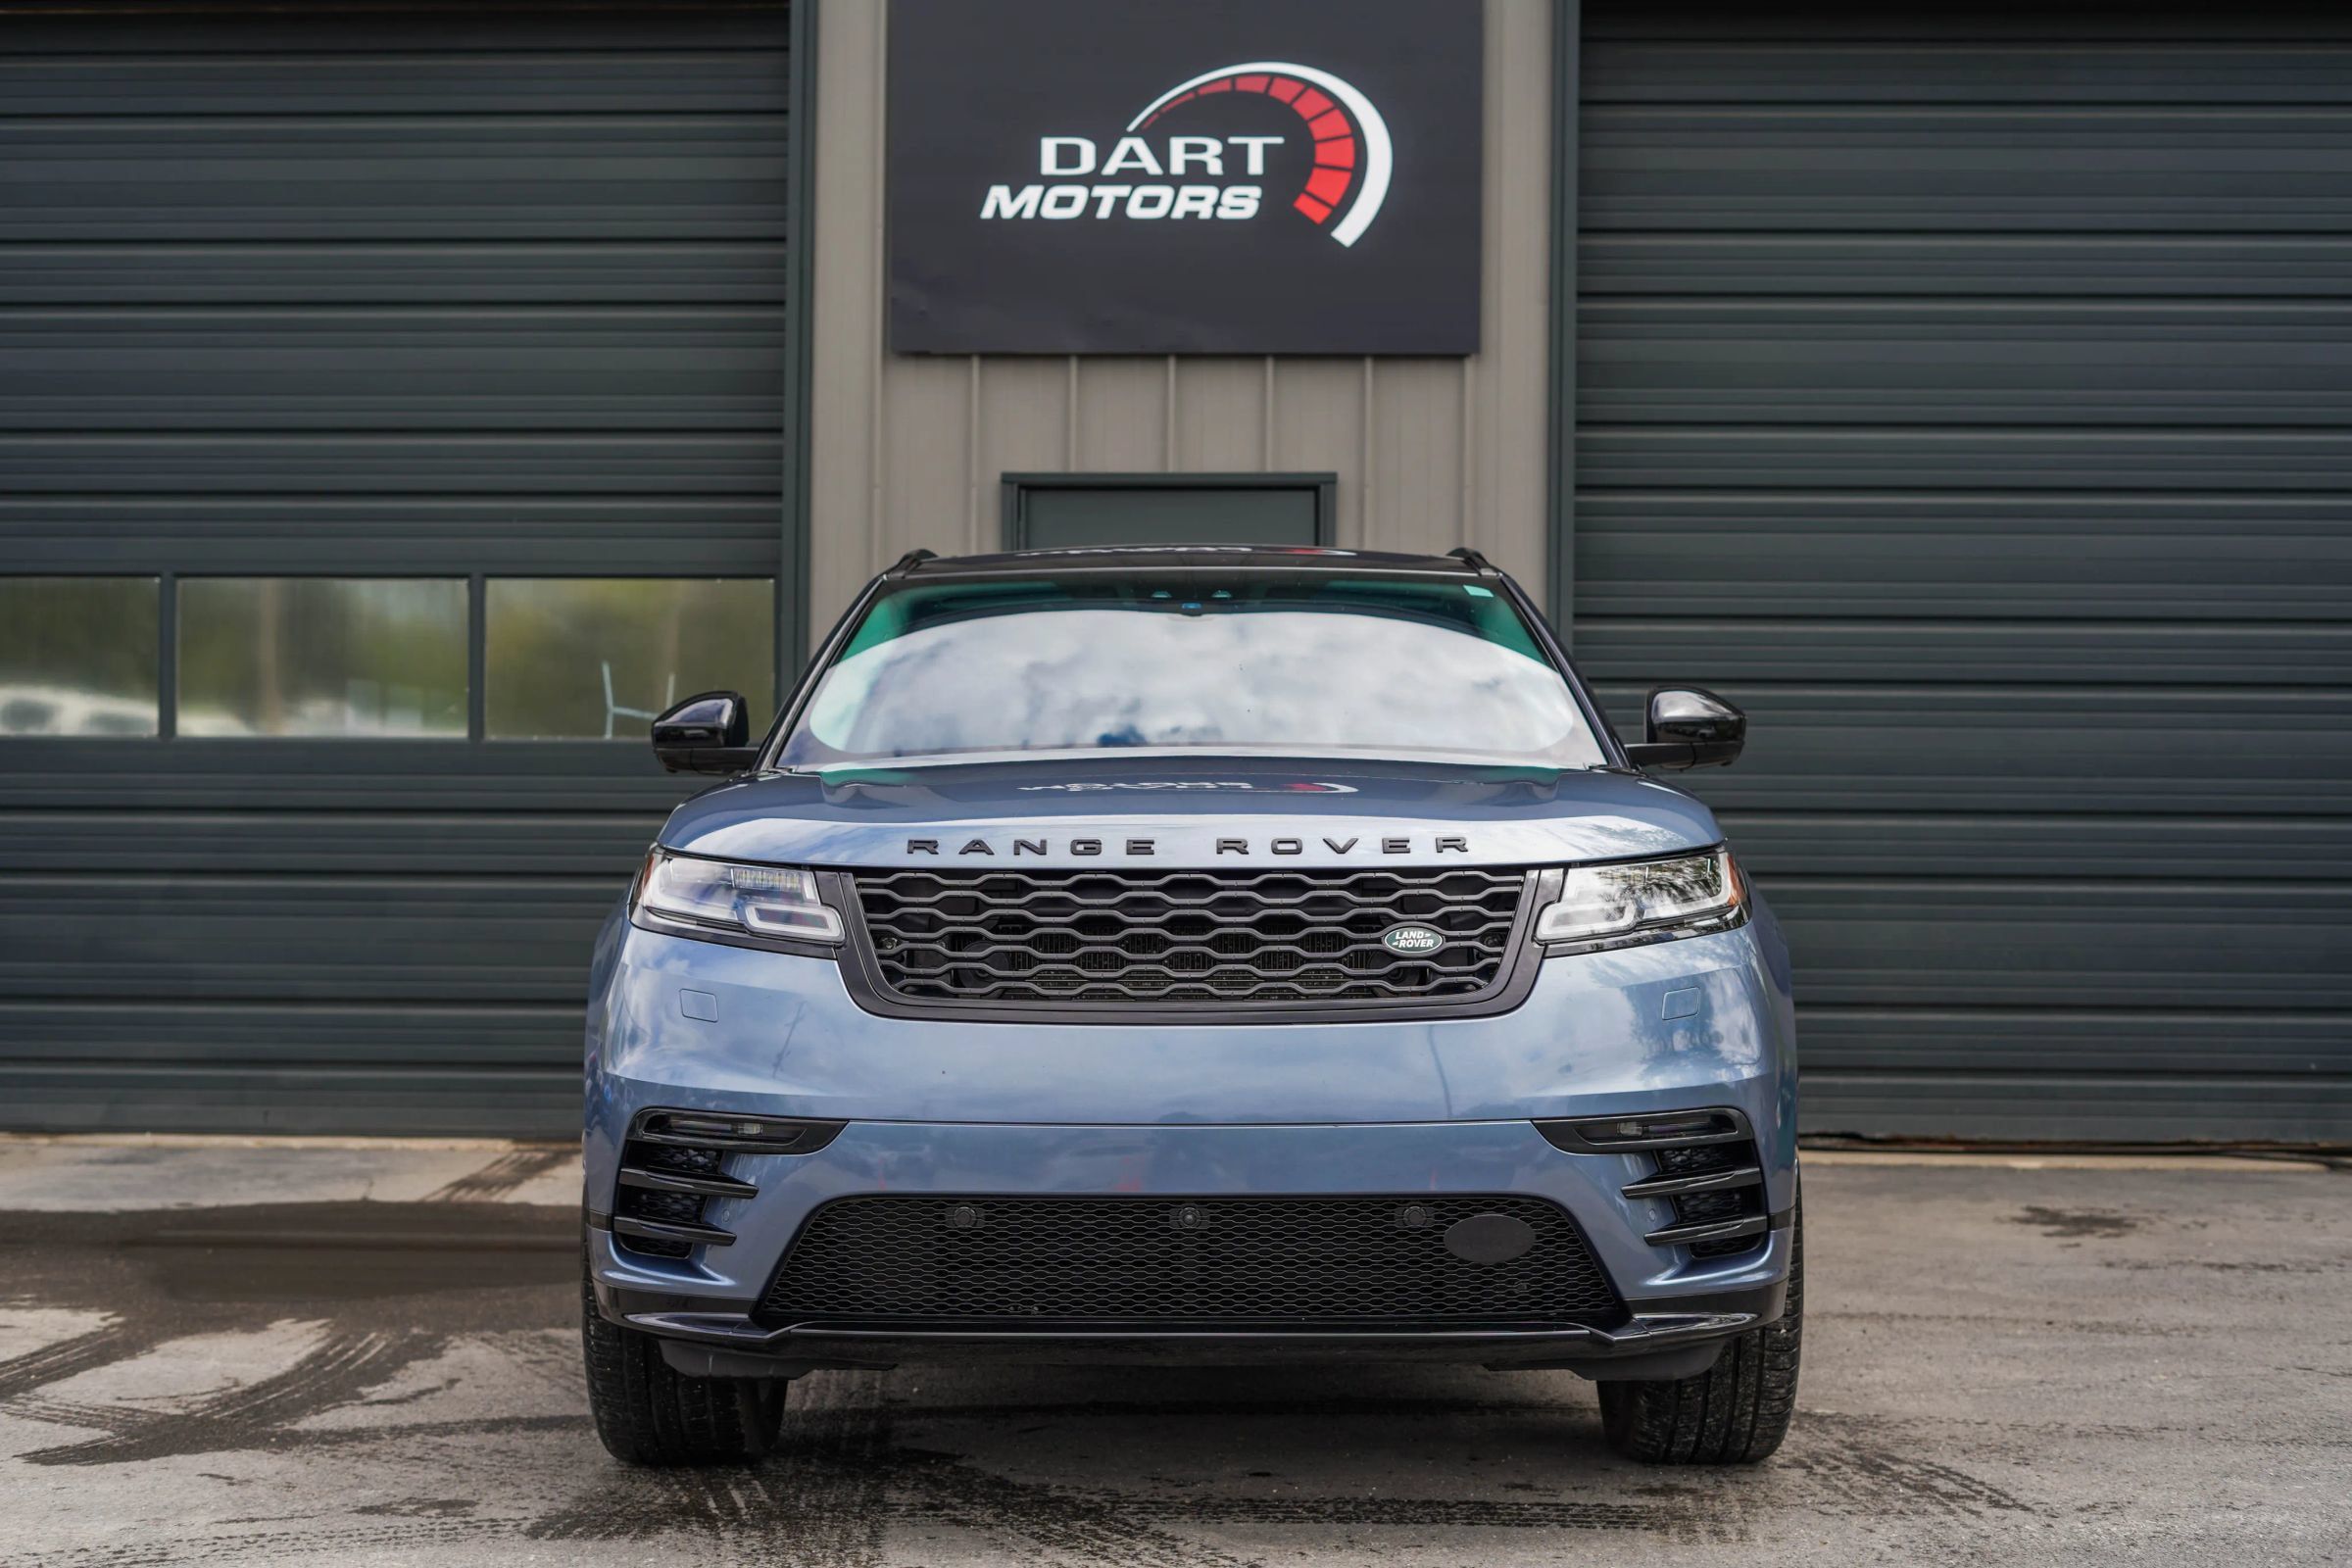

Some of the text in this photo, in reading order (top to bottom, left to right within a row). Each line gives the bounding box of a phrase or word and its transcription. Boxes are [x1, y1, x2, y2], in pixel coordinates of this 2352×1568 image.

[1041, 136, 1285, 176] DART
[979, 184, 1262, 220] MOTORS
[906, 836, 1470, 856] RANGE ROVER
[1395, 930, 1425, 940] LAND
[1397, 939, 1435, 949] ROVER
